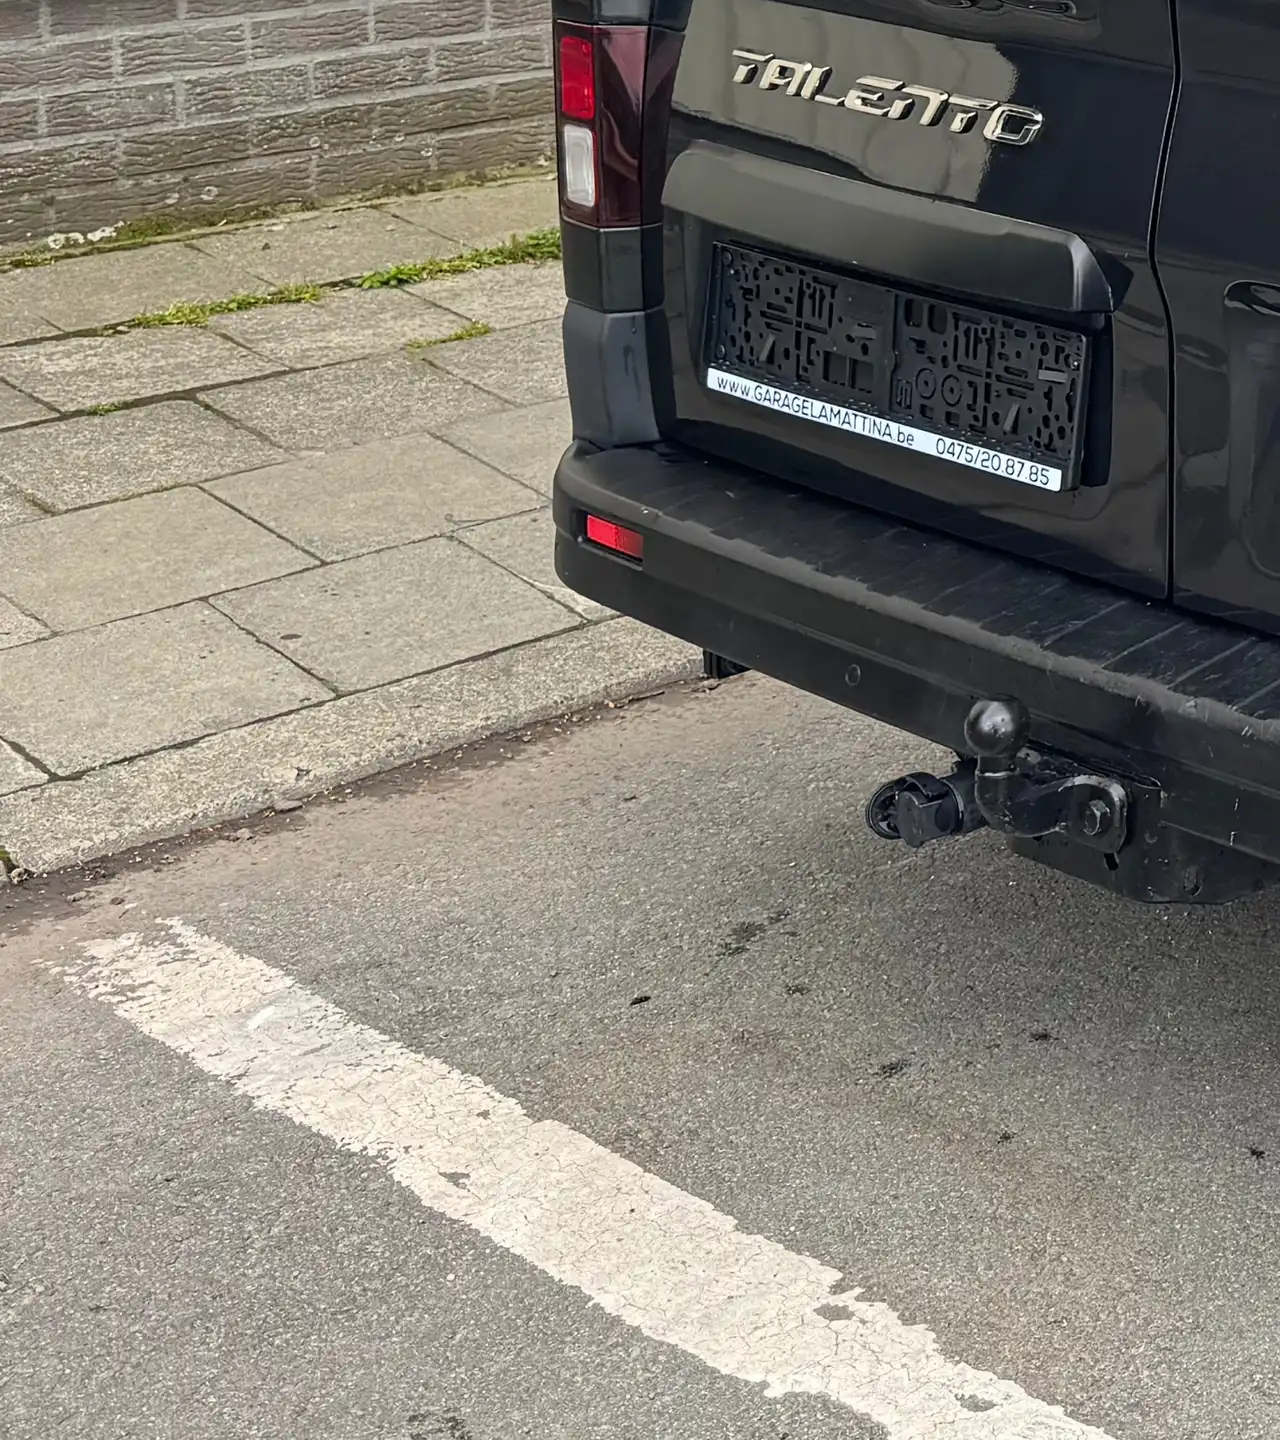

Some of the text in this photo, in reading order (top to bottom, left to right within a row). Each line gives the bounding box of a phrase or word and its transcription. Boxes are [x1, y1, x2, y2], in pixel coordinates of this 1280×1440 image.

[732, 47, 1044, 146] TALENTO
[716, 374, 1051, 486] www.GARAGELAMATTINA.be 0475/20.87.85
